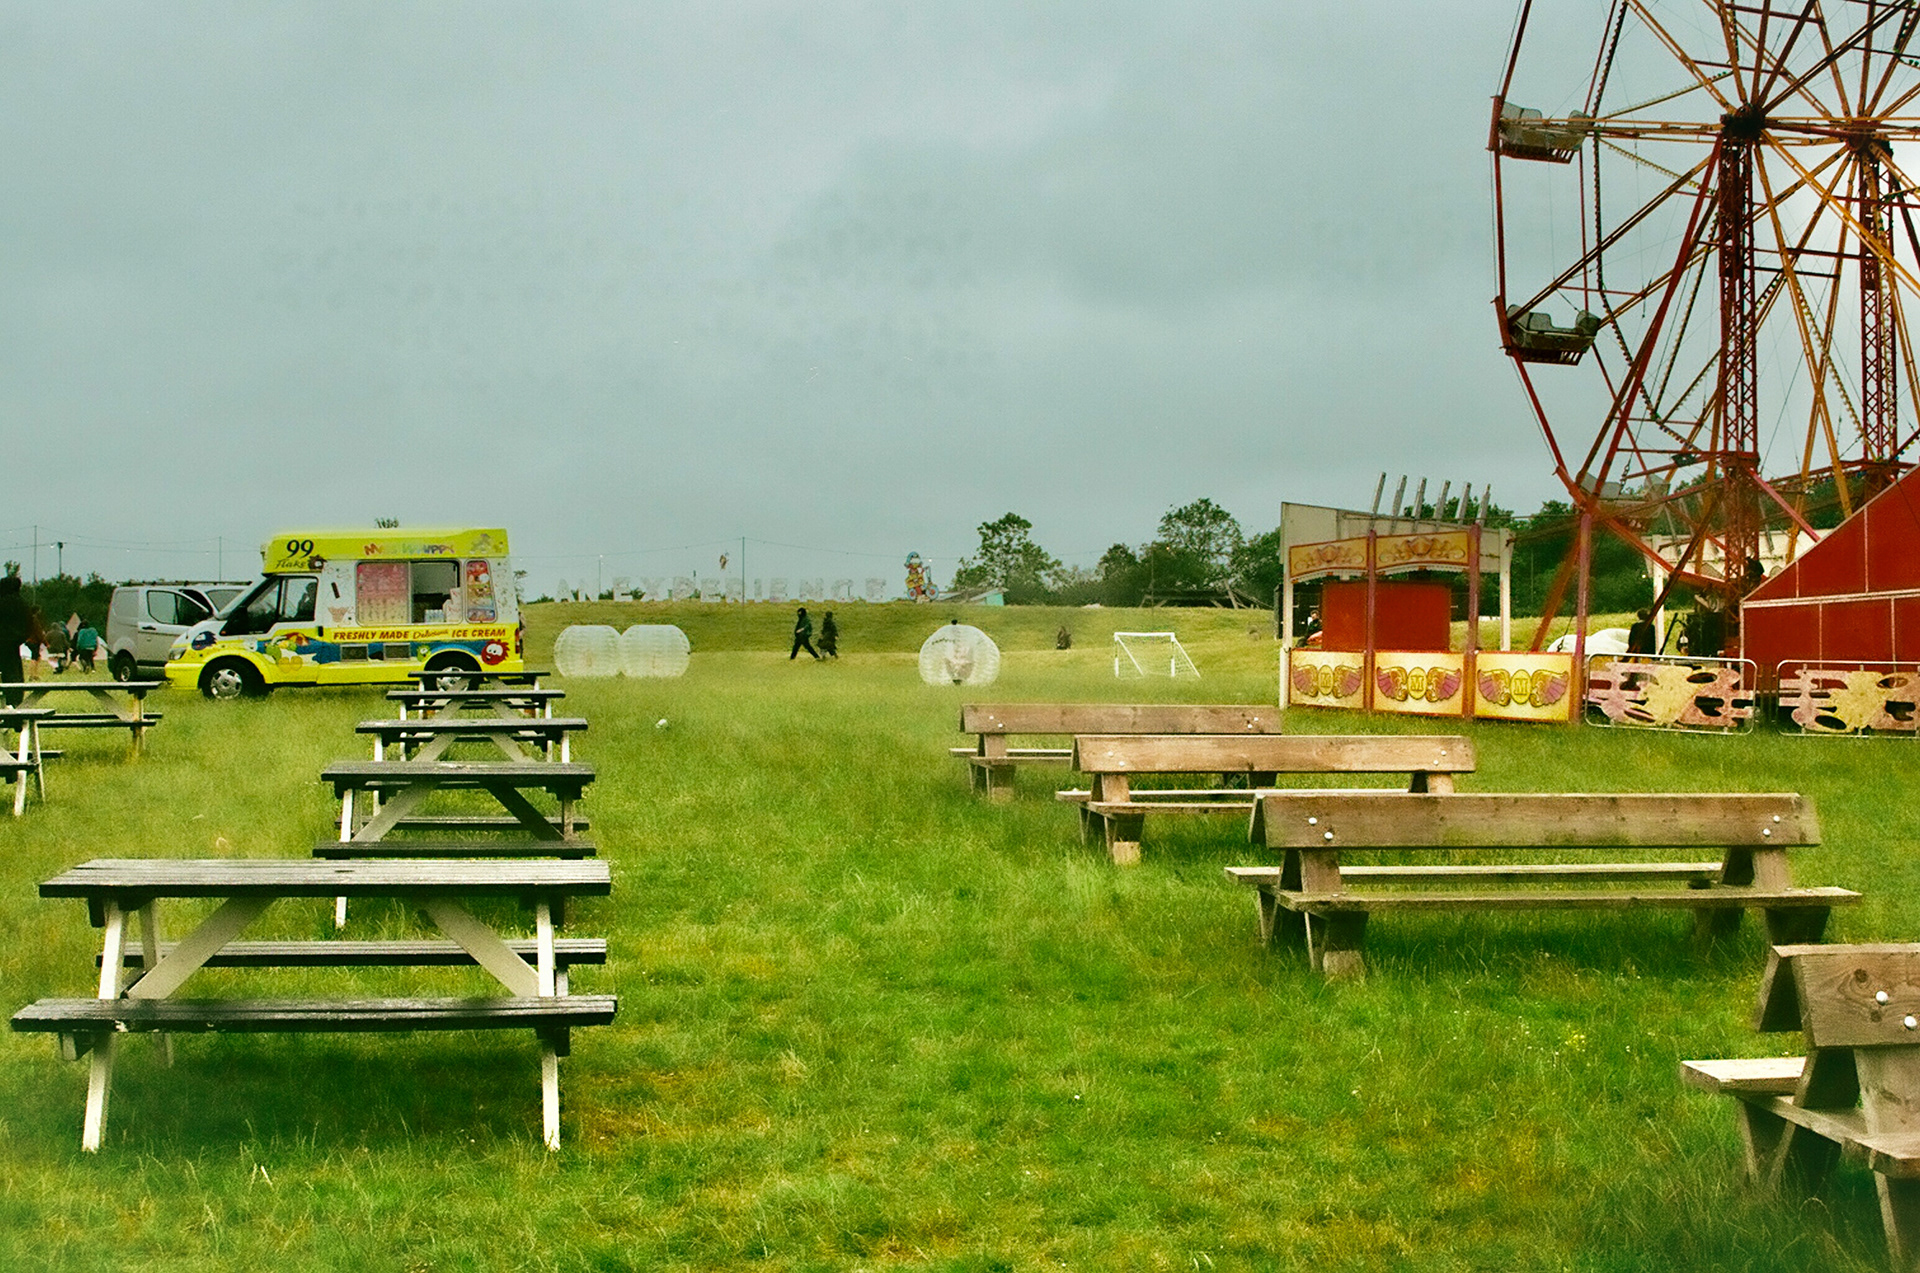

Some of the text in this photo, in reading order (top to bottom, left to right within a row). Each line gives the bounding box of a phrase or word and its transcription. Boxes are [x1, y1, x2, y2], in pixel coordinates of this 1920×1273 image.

[286, 539, 314, 559] 99
[613, 576, 887, 603] EXPERIENCE
[333, 631, 377, 640] FRESHLY
[379, 630, 409, 640] MADE
[452, 629, 468, 638] ICE
[471, 628, 506, 638] CREAM
